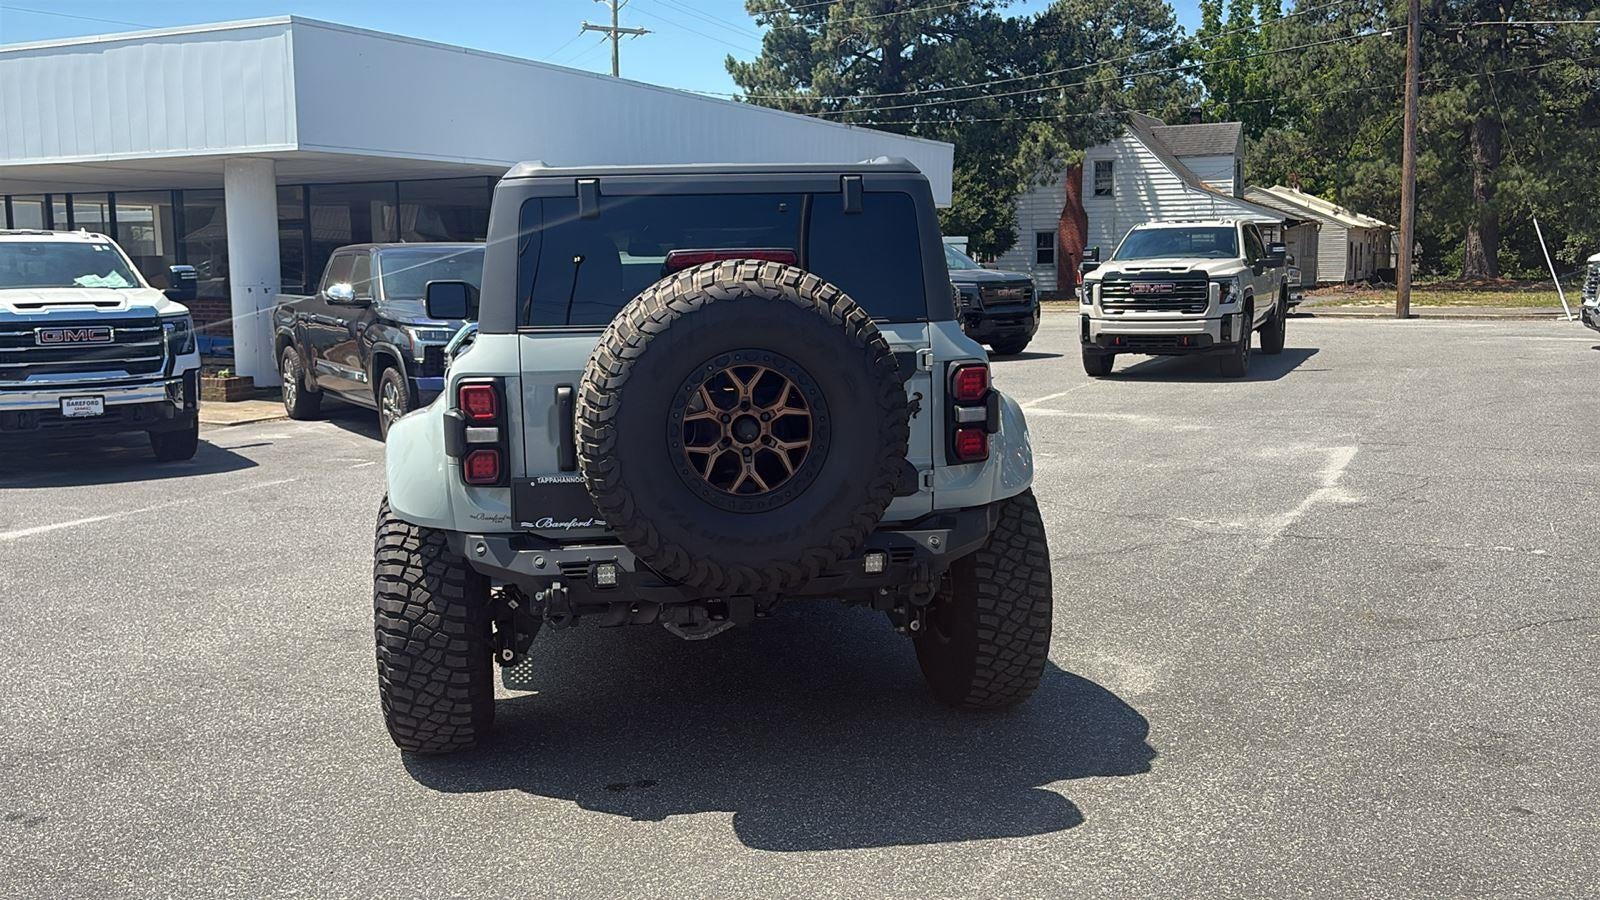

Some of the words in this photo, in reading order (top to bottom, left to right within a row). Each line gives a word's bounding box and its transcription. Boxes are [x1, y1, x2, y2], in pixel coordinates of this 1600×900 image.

[997, 288, 1021, 297] GMC
[1133, 284, 1173, 293] GMC
[41, 329, 109, 343] GMC
[535, 517, 593, 530] Bareford
